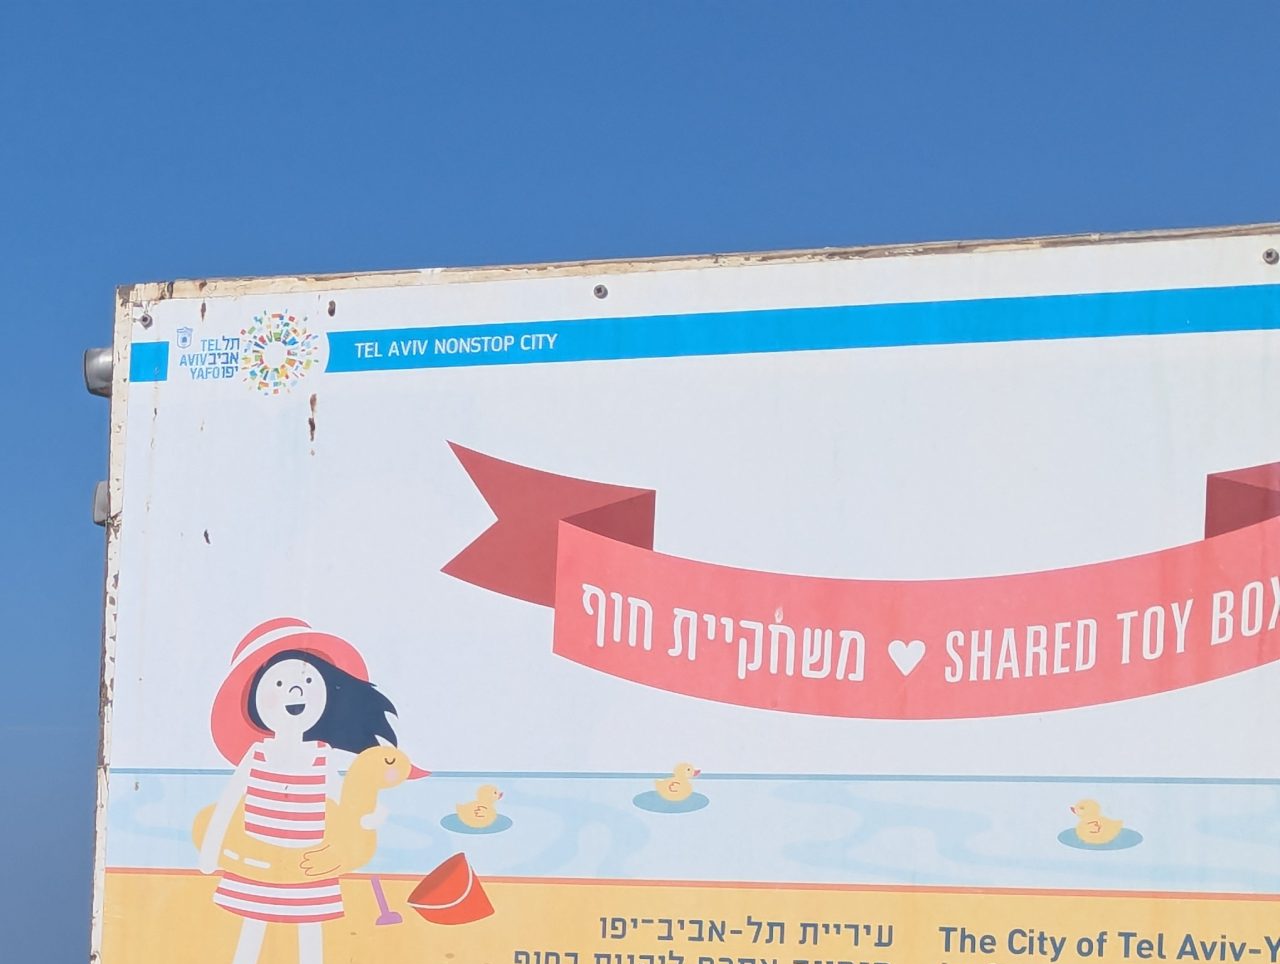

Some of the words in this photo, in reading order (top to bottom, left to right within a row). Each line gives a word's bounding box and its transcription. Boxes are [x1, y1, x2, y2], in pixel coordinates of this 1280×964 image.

[200, 338, 221, 352] TEL
[222, 335, 240, 351] תל
[354, 342, 383, 359] TEL
[387, 339, 428, 357] AVIV
[434, 335, 515, 354] NONSTOP
[520, 333, 558, 351] CITY
[179, 353, 207, 367] AVIV
[207, 351, 239, 366] אביב
[190, 366, 220, 380] YAFO
[221, 365, 239, 379] יפו
[581, 583, 653, 651] חוף
[668, 606, 866, 682] משחקיית
[944, 617, 1098, 683] SHARED
[1116, 598, 1194, 665] TOY
[798, 921, 894, 949] עיריית
[939, 926, 997, 954] The
[1007, 928, 1067, 963] City
[1076, 931, 1108, 958] of
[1118, 931, 1167, 960] Tel
